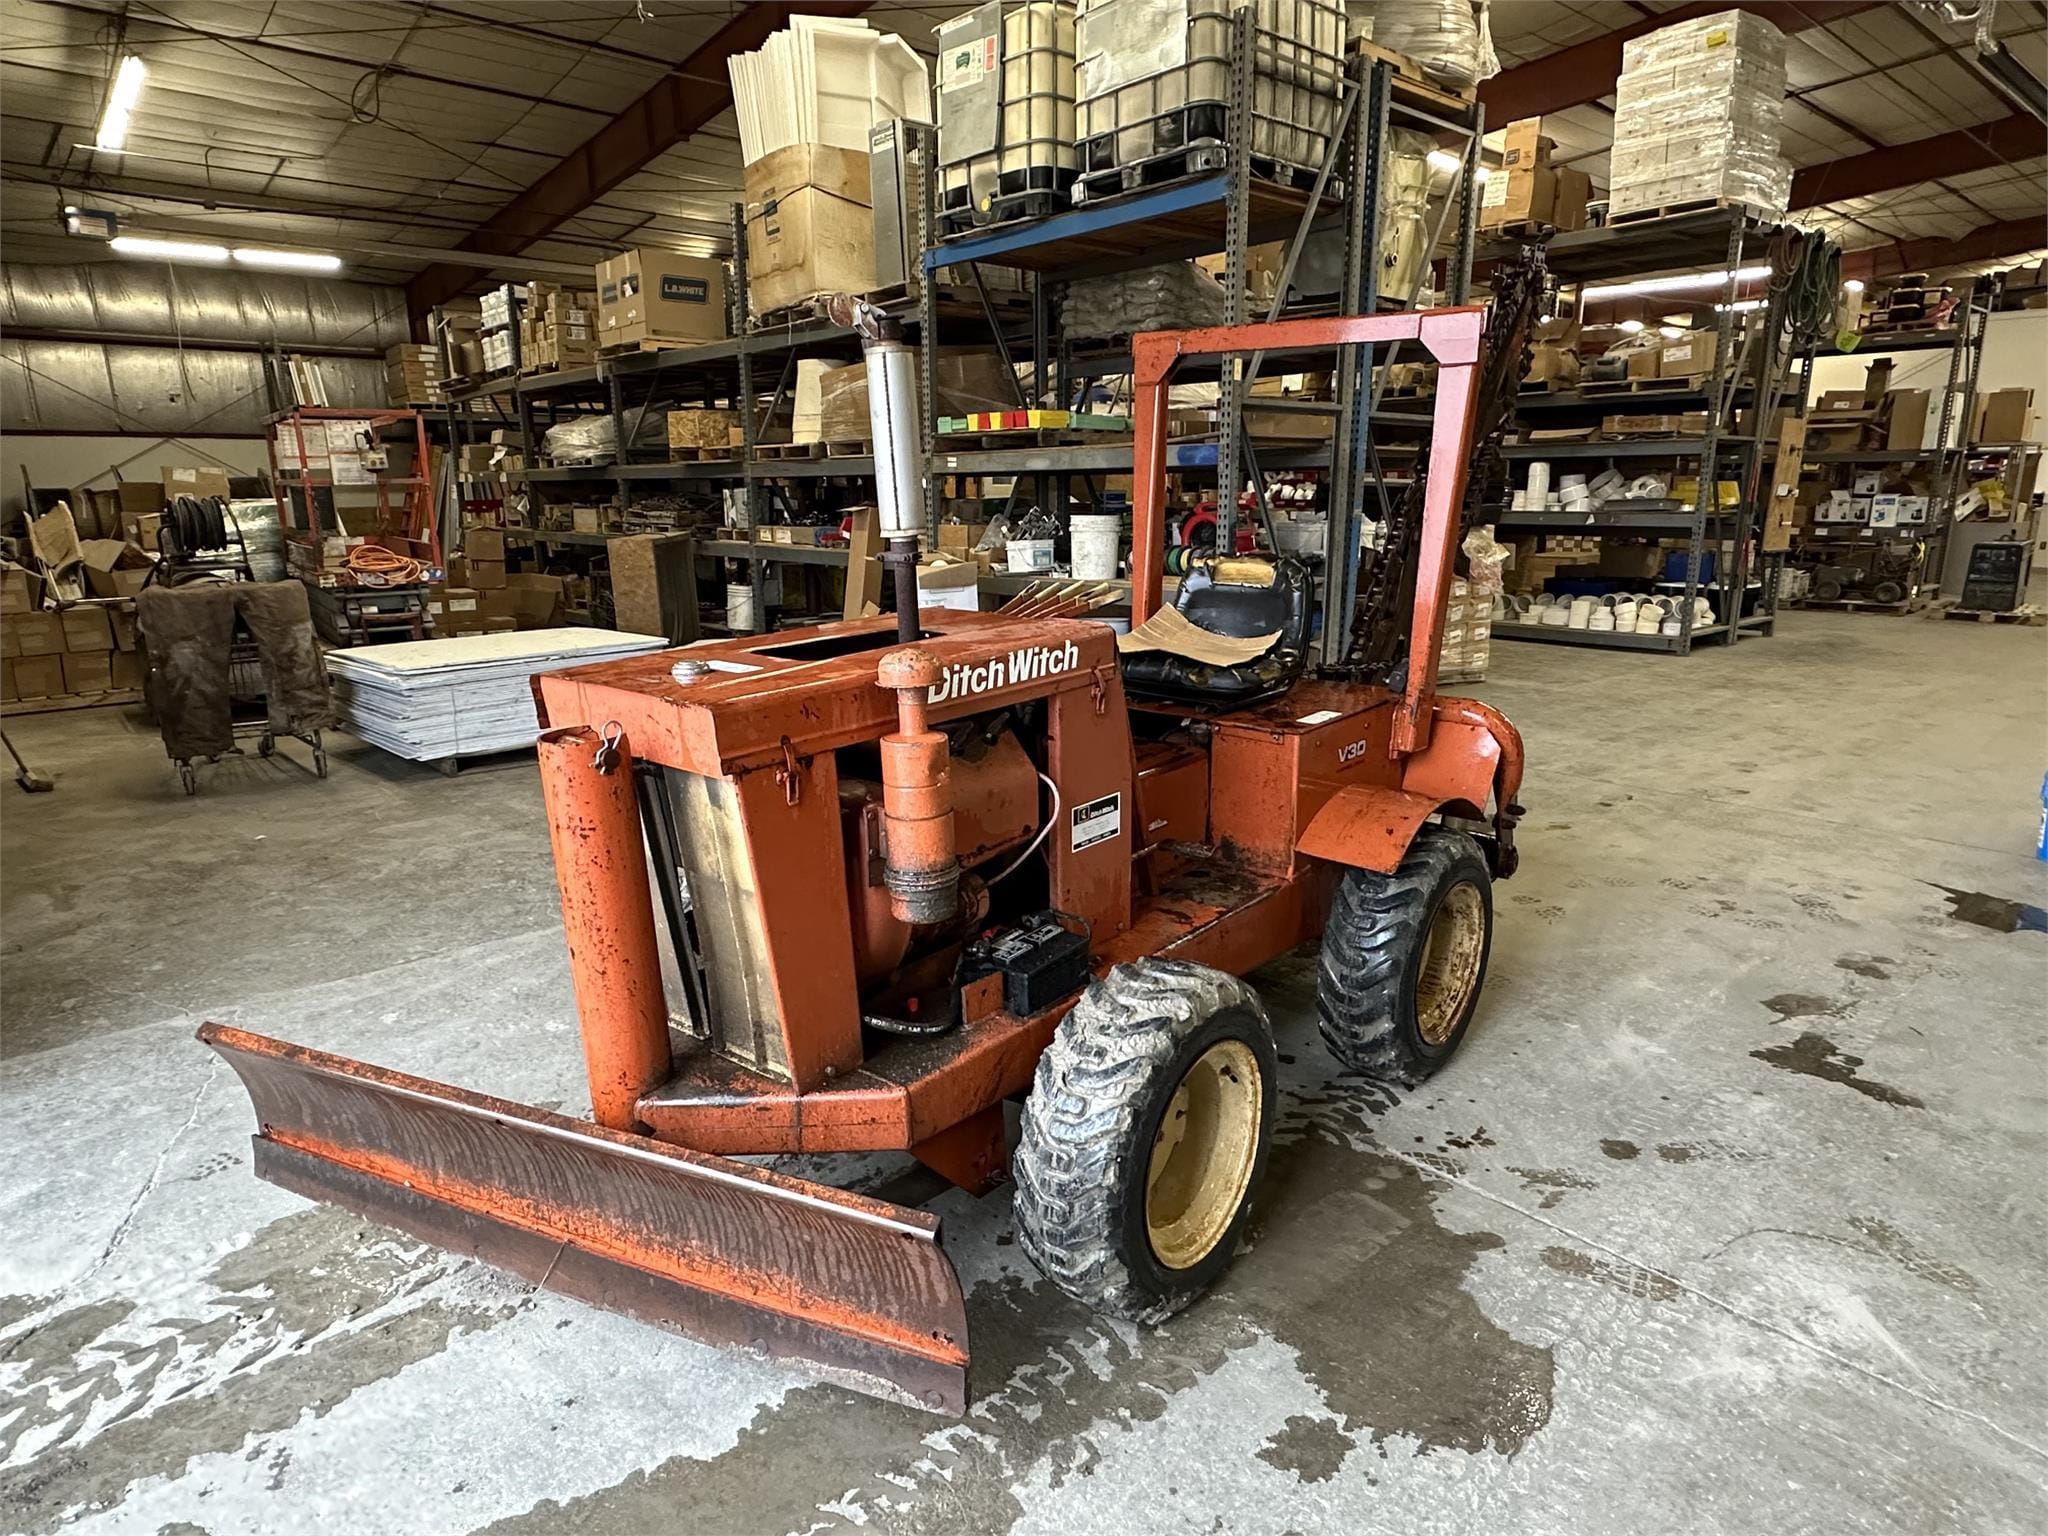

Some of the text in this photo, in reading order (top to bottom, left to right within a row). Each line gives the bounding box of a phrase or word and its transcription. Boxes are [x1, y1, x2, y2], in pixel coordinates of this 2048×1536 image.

[928, 639, 1079, 704] Ditch Witch
[1338, 739, 1366, 762] V30
